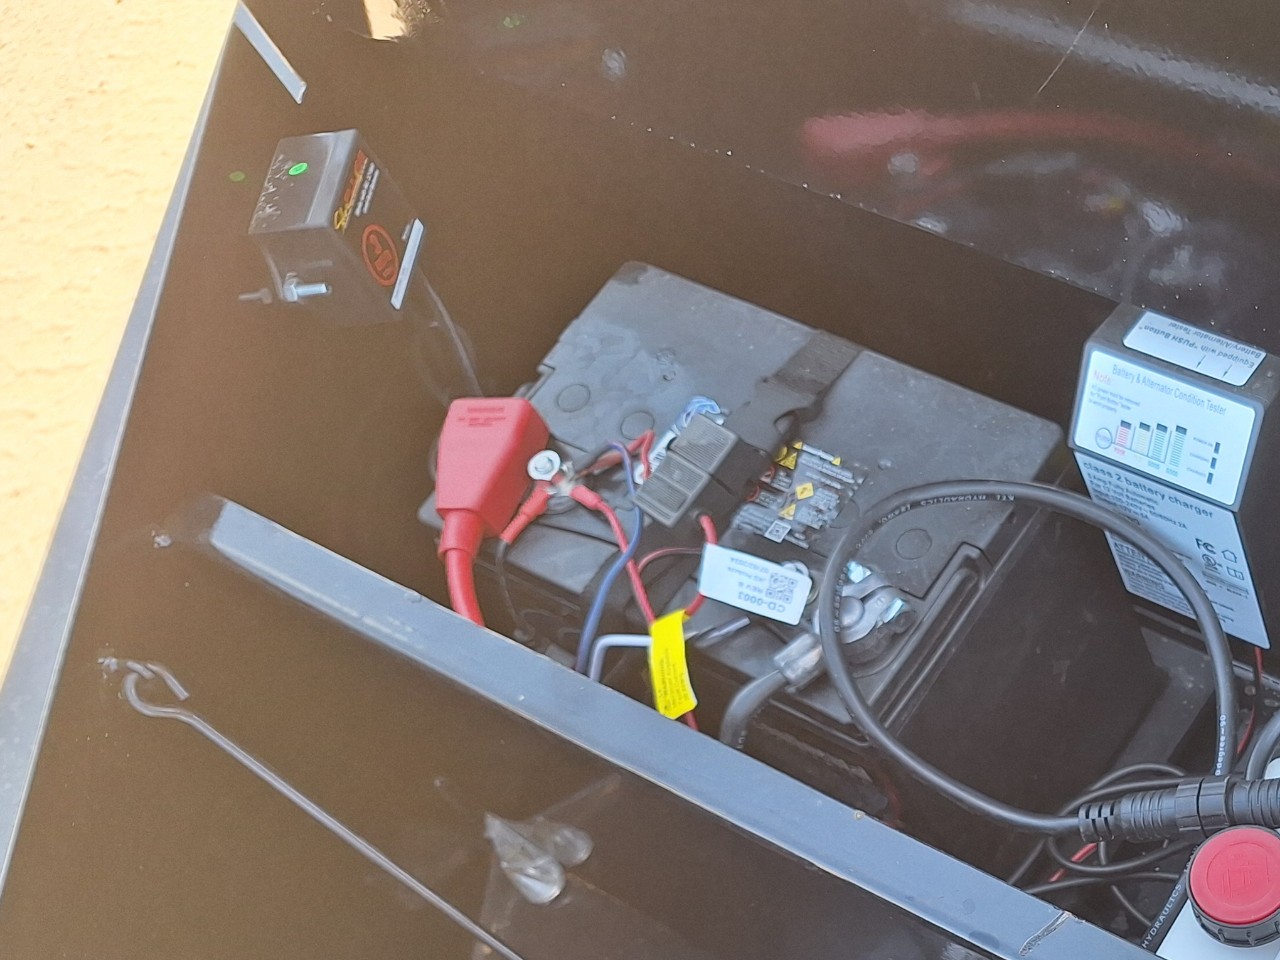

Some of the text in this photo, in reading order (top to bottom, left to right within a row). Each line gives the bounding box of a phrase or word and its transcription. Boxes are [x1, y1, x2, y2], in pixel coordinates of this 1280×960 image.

[1167, 321, 1191, 333] Tester
[1200, 344, 1216, 354] with
[1216, 350, 1255, 368] Equipped
[1111, 364, 1135, 383] Battery
[1140, 376, 1173, 396] Alternator
[1173, 388, 1205, 409] Condition
[1205, 400, 1227, 416] Tester
[1083, 460, 1214, 520] class 2 battery charger
[1141, 883, 1182, 947] HYDRAULICS
